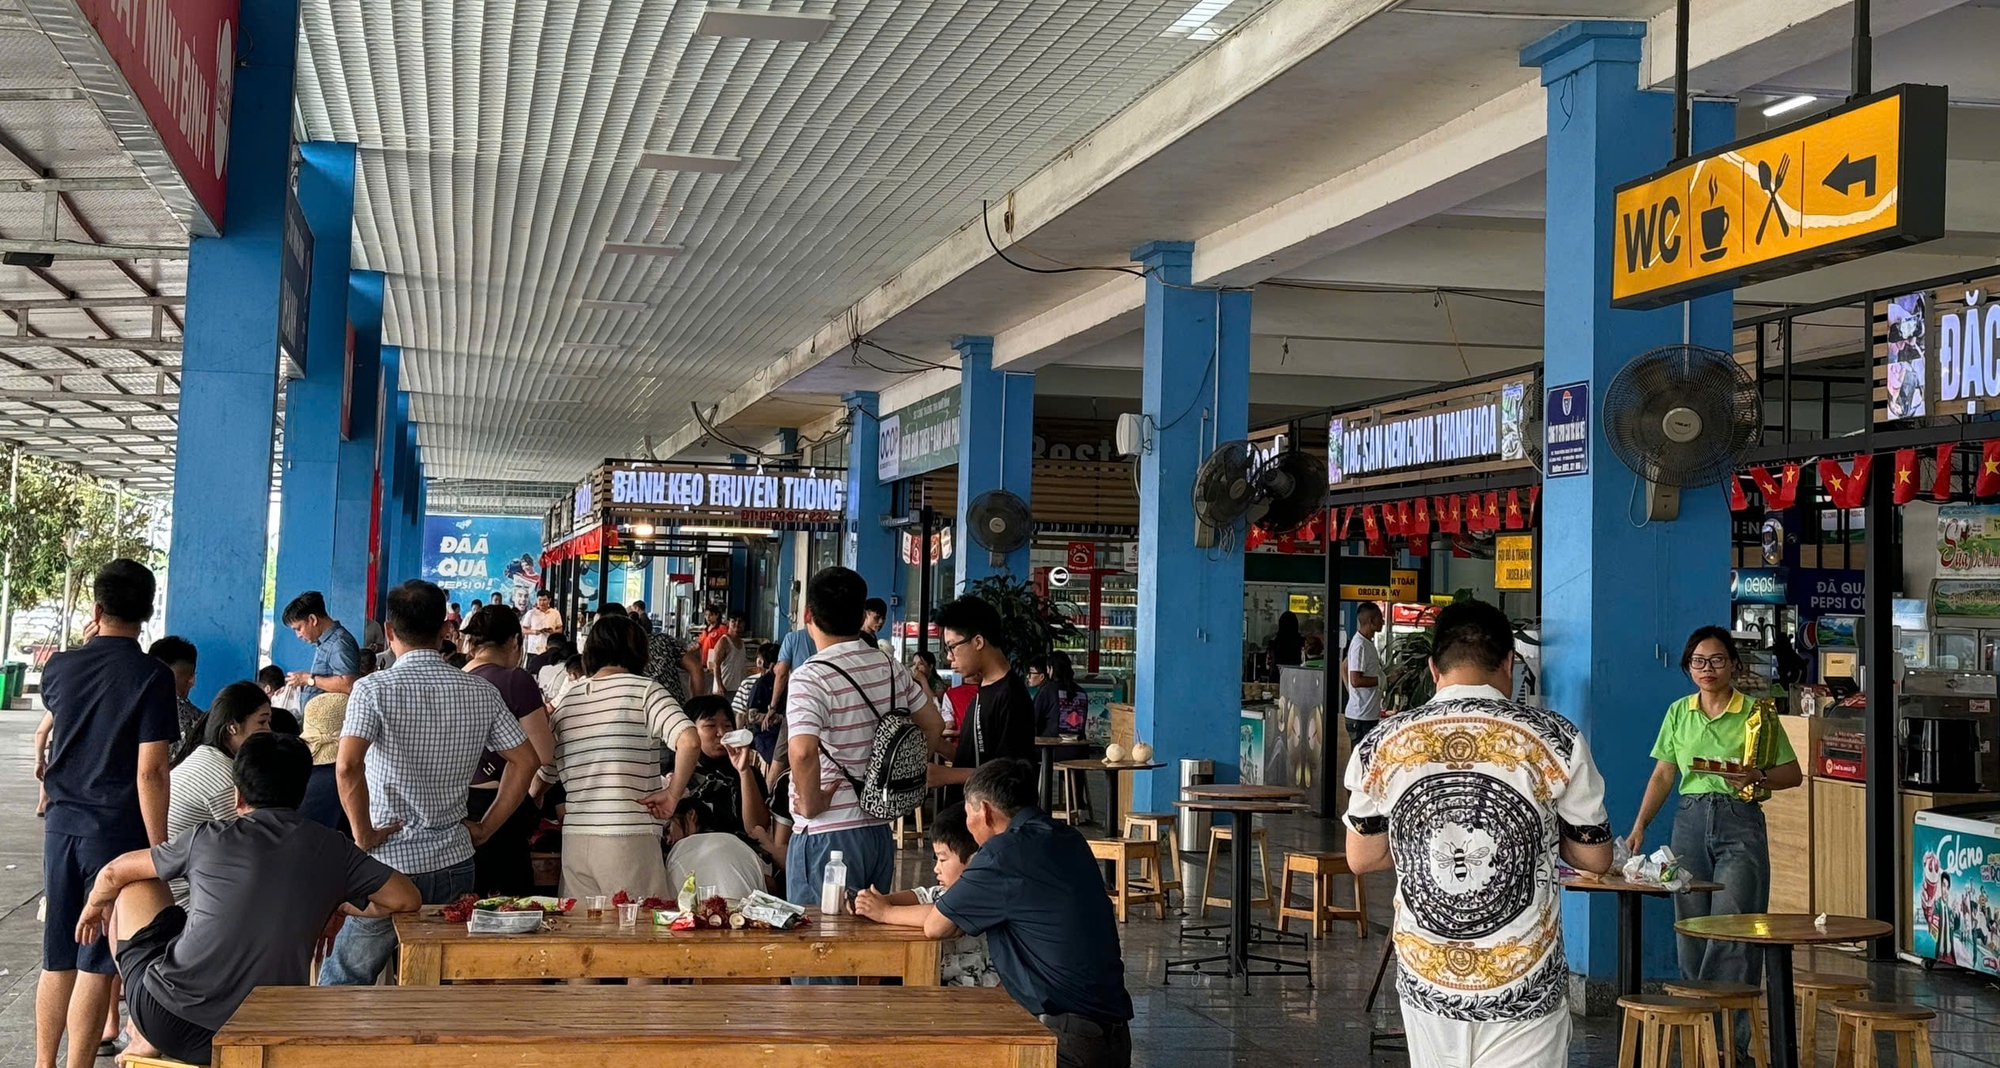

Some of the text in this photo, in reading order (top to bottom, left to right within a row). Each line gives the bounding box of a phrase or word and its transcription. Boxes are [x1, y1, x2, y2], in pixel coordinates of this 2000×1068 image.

[1623, 195, 1681, 274] WC
[1384, 421, 1407, 469] NEM
[1407, 415, 1434, 466] CHUA
[1436, 408, 1472, 461] THANH
[612, 463, 666, 504] BÁNH
[668, 473, 704, 511] KẸO
[708, 465, 779, 508] TRUYỀN
[783, 467, 843, 511] THỐNG
[440, 533, 489, 554] ĐÃÃ
[437, 556, 488, 578] QUÁ
[437, 581, 472, 590] PEPSI
[1358, 588, 1380, 596] ORDER
[1381, 588, 1387, 596] &
[1744, 573, 1777, 598] pepsi
[1816, 579, 1837, 594] ĐÃ
[1811, 596, 1846, 608] PEPSI
[1936, 834, 1983, 877] Celano
